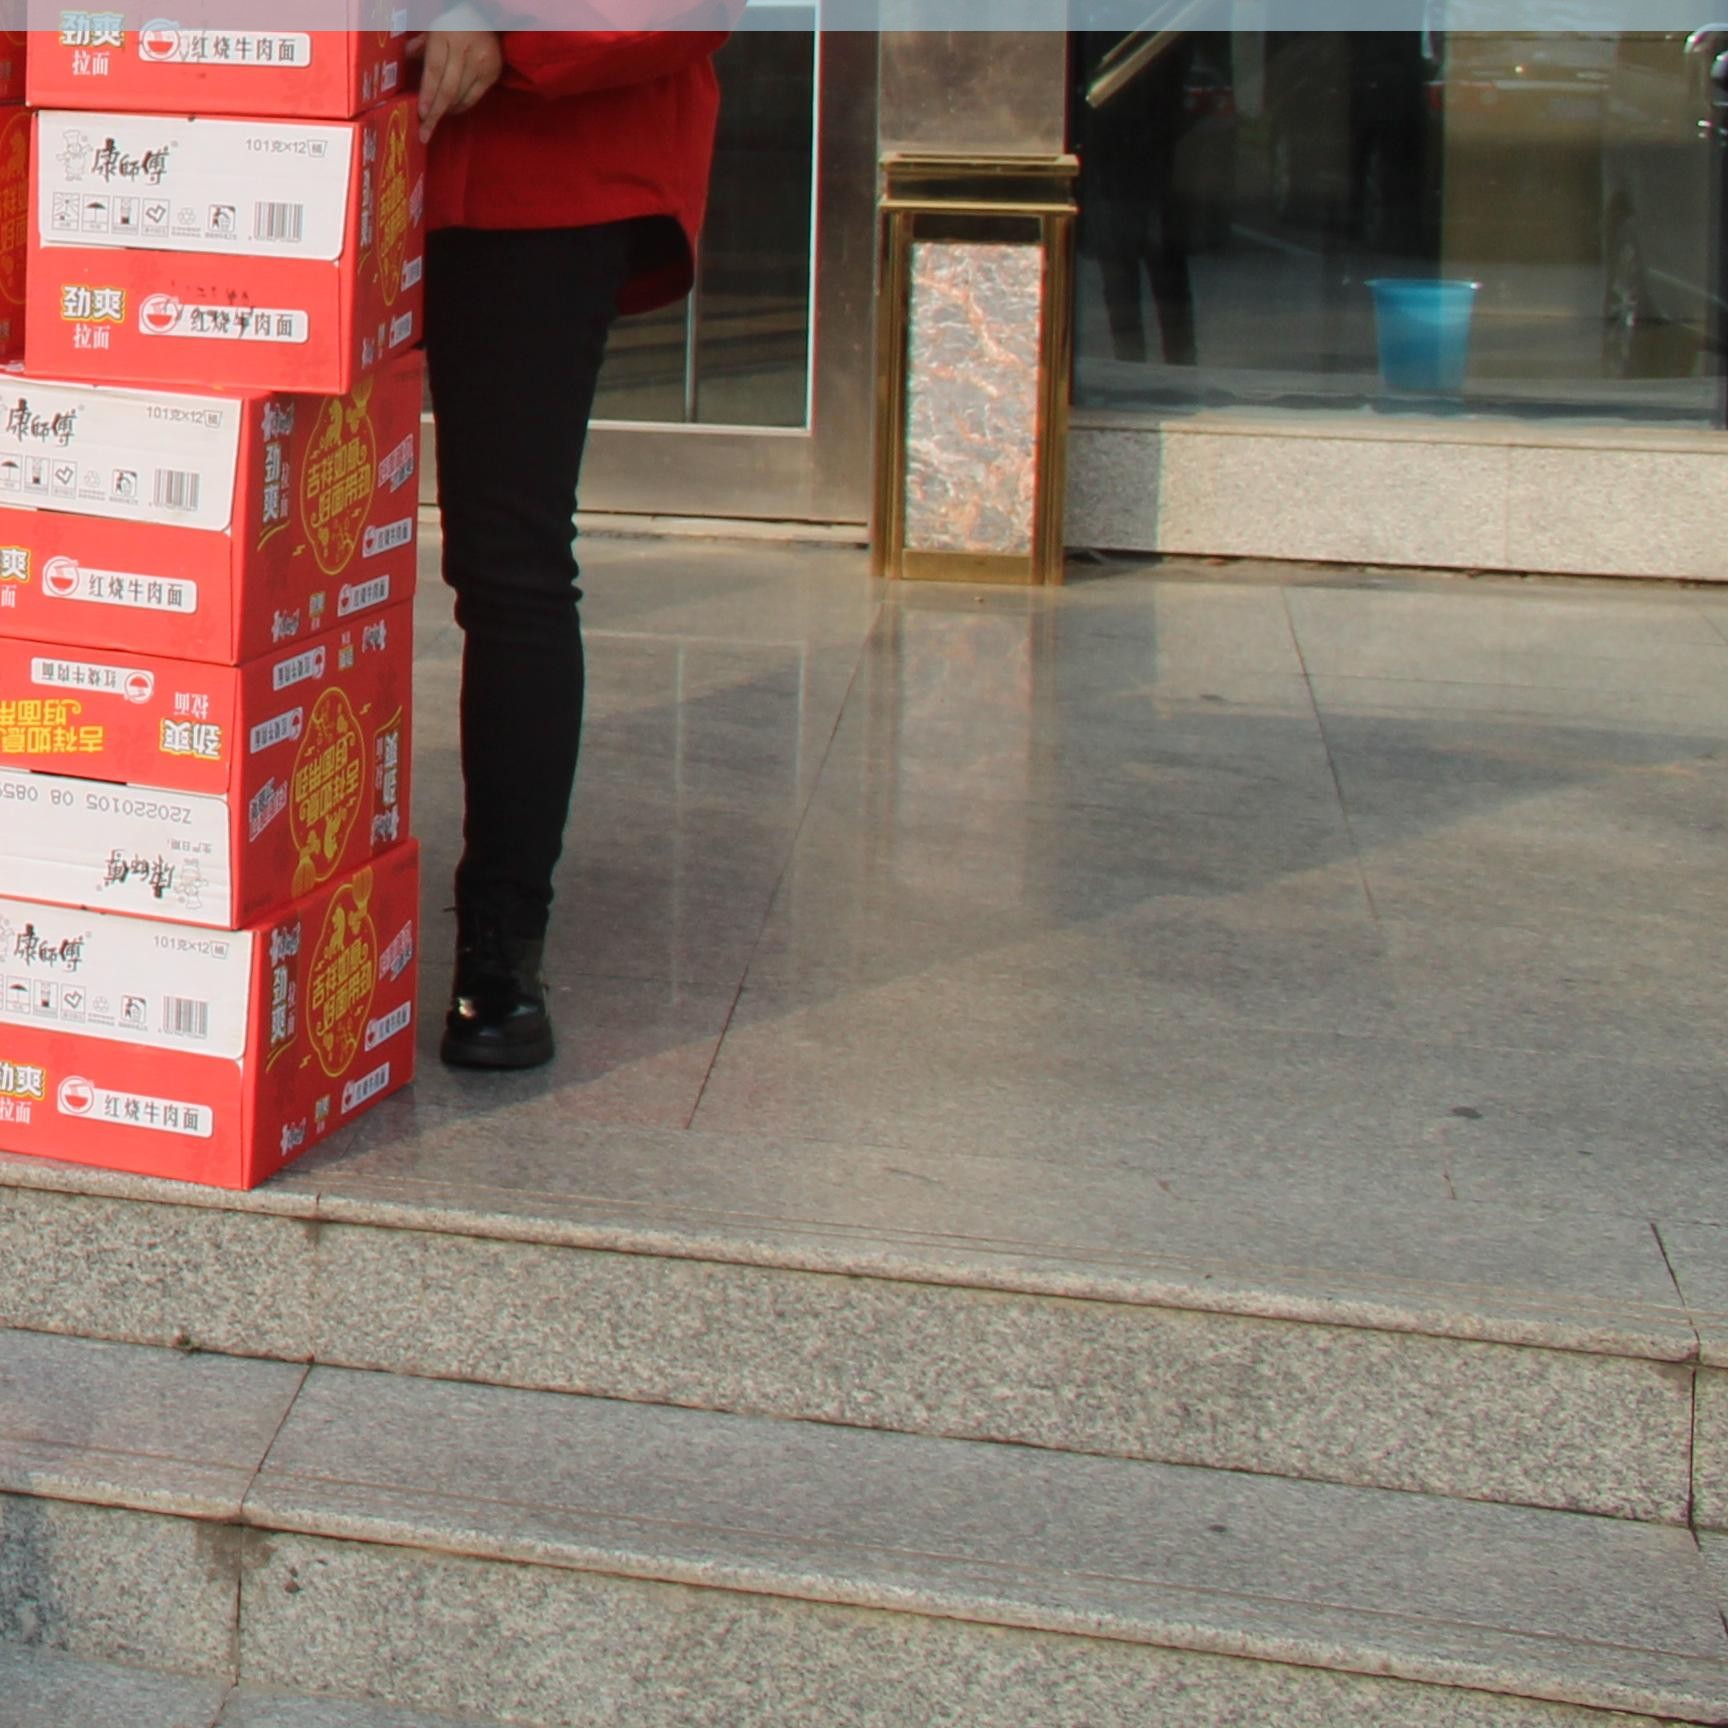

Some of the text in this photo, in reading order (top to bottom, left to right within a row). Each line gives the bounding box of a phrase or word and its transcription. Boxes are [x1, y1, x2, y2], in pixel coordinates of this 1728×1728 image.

[59, 10, 124, 48] 劲爽
[72, 50, 109, 76] 拉面
[191, 37, 296, 62] 红烧牛肉面
[60, 285, 126, 323] 劲爽
[73, 324, 110, 350] 拉面
[190, 310, 294, 338] 红烧牛肉面
[89, 573, 183, 607] 红烧牛肉面
[40, 661, 117, 687] 红烧牛肉面
[174, 691, 209, 719] 拉面
[159, 718, 222, 760] 劲爽
[51, 790, 74, 807] 08
[87, 796, 192, 824] Z20220105
[104, 1093, 200, 1131] 红烧牛肉面
